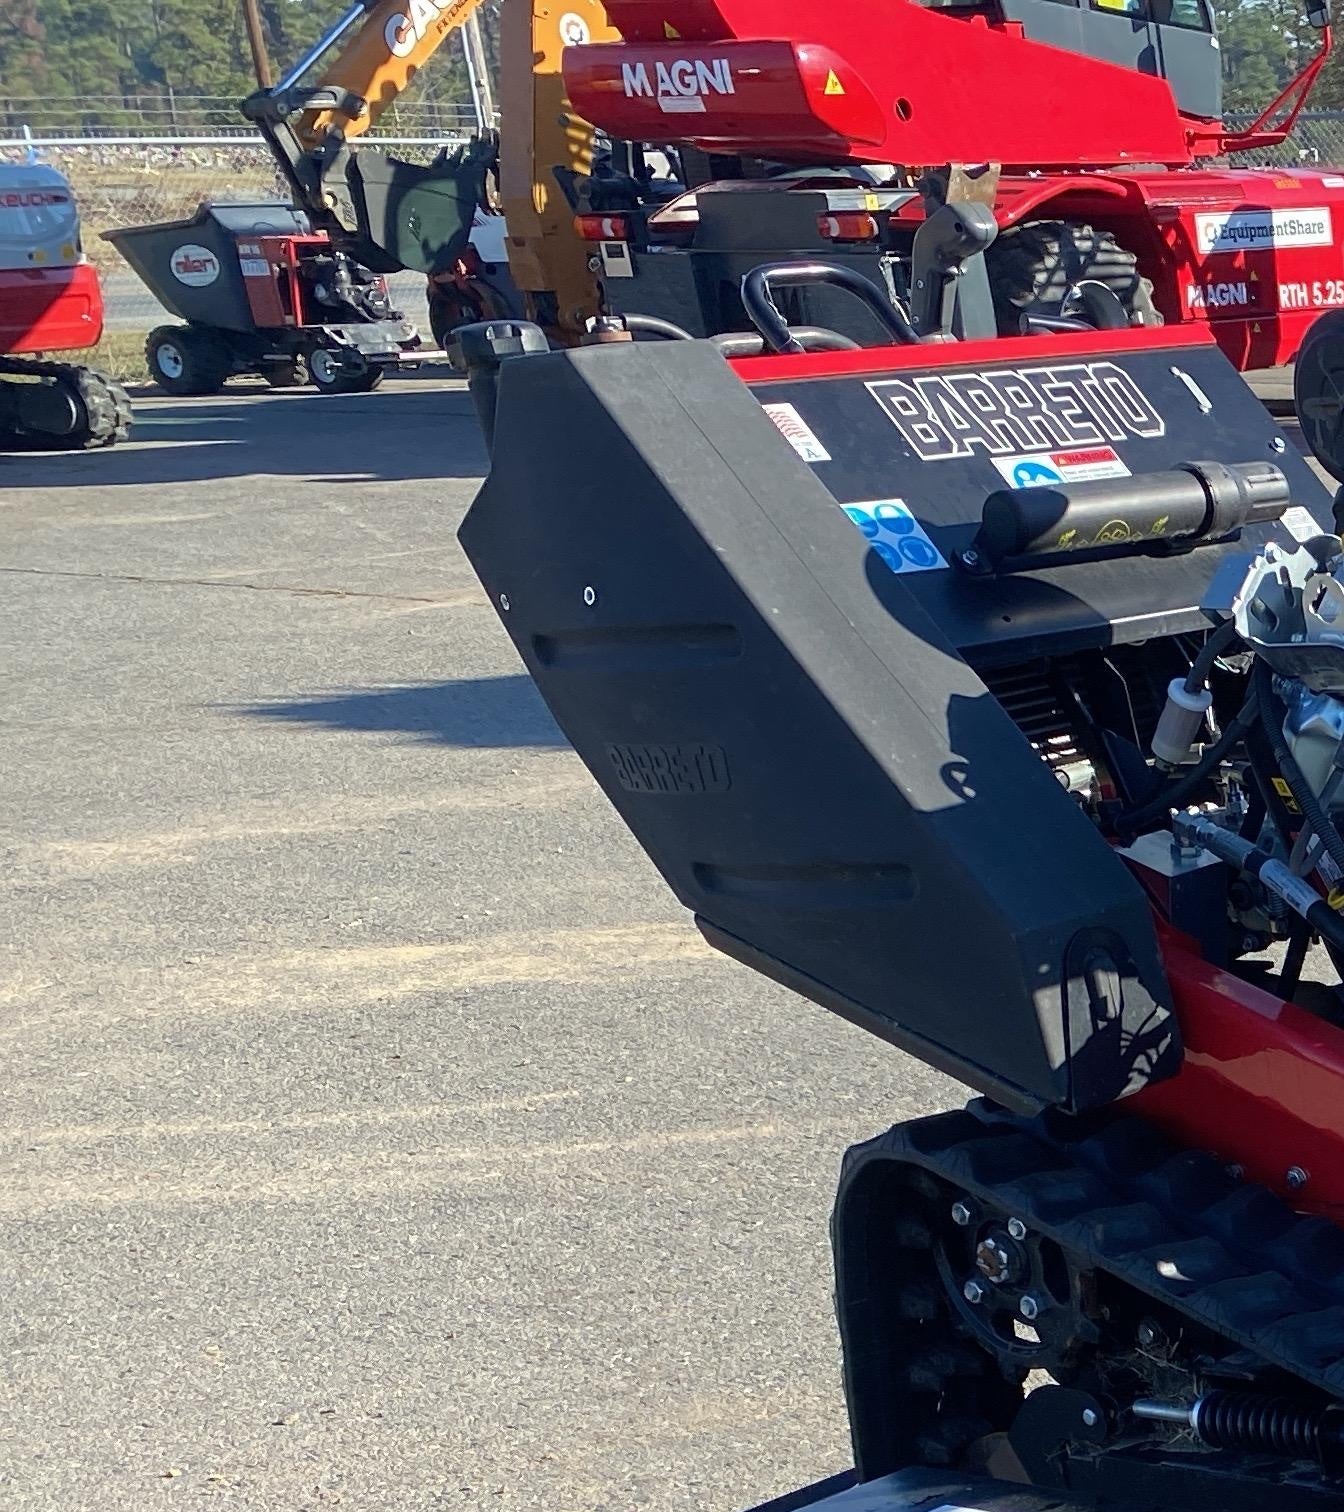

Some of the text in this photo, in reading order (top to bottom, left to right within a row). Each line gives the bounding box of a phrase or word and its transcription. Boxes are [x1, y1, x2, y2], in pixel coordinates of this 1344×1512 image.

[621, 58, 737, 98] MAGNI
[1220, 219, 1325, 243] EquipmentShare
[1187, 281, 1248, 308] MAGNI
[1279, 282, 1310, 309] RTH
[864, 361, 1165, 461] BARRETO
